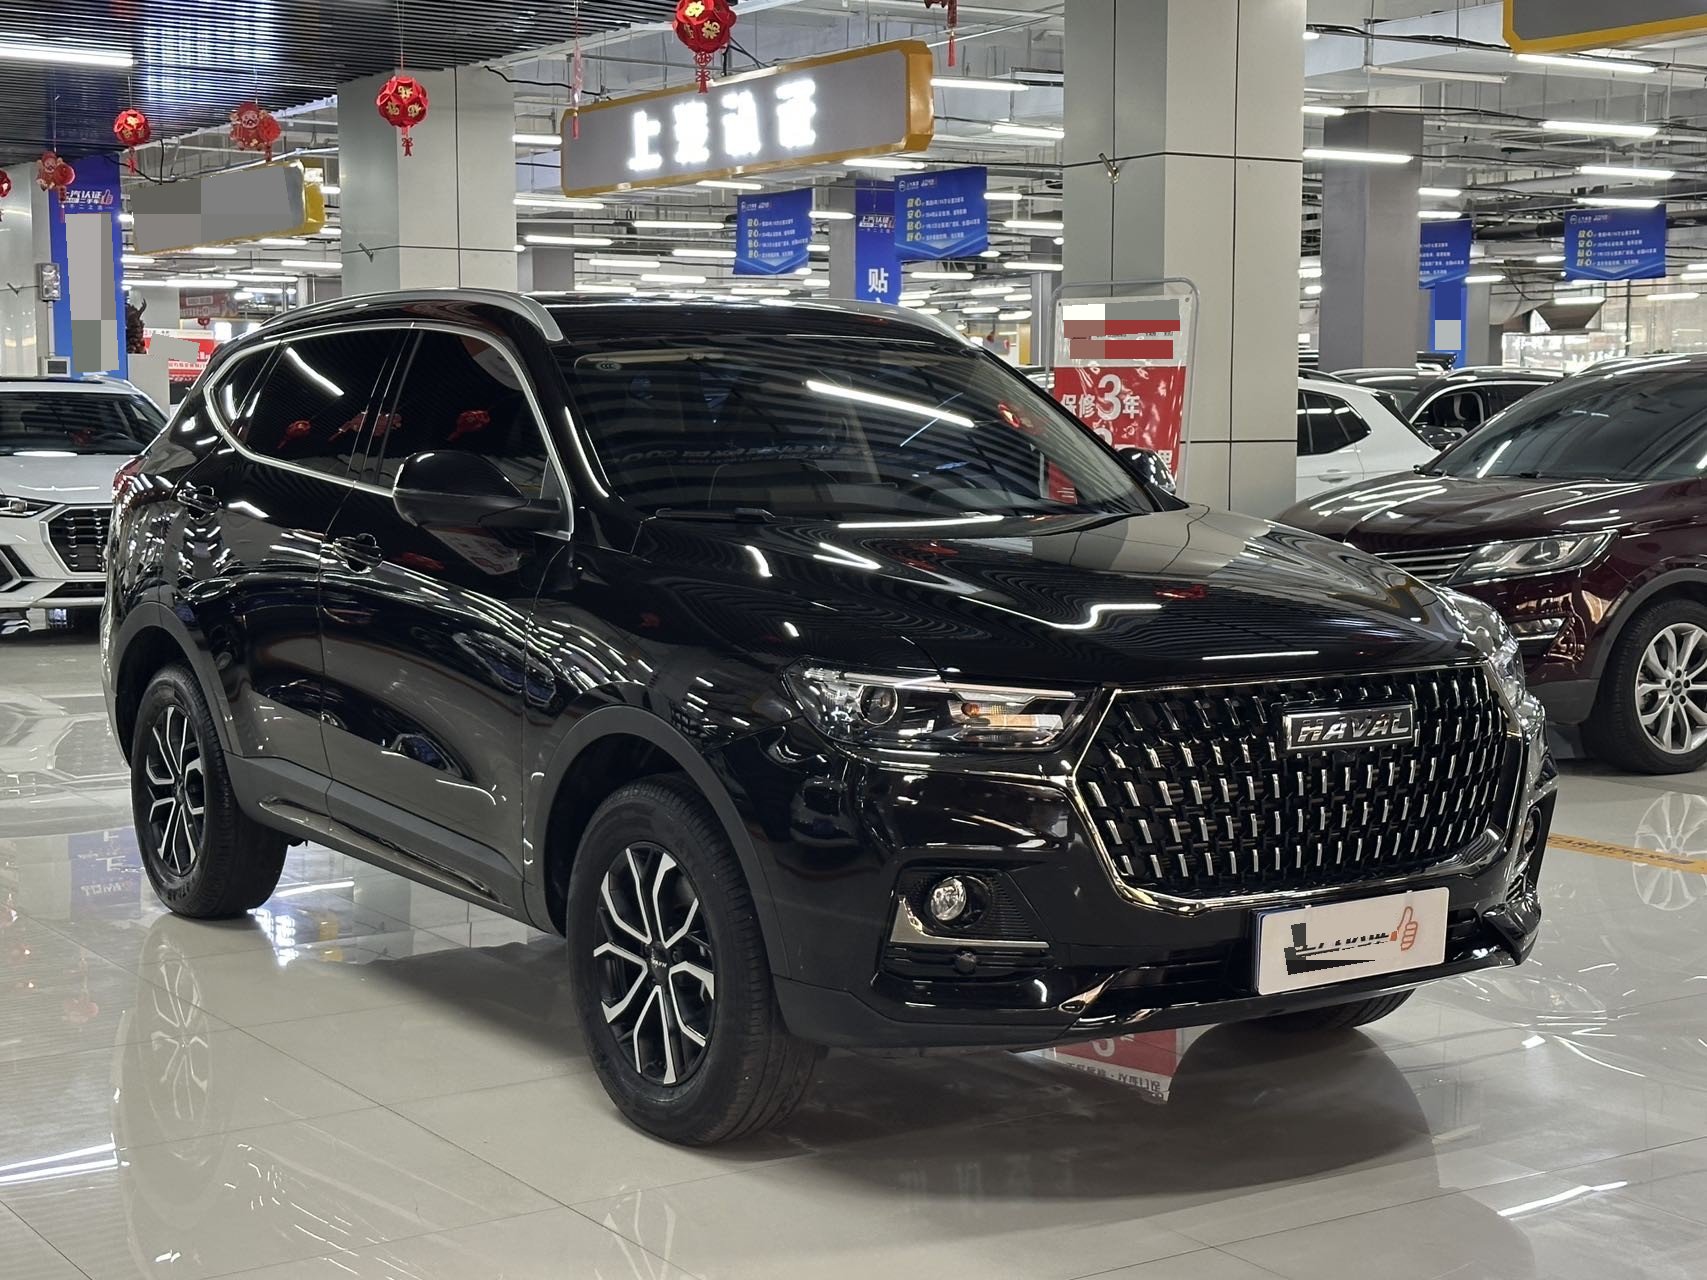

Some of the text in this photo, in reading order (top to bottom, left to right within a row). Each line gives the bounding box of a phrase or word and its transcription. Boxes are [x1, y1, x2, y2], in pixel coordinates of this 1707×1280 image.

[868, 268, 889, 303] 贴
[1060, 374, 1141, 421] 保修3年
[1297, 713, 1410, 743] HAVAL
